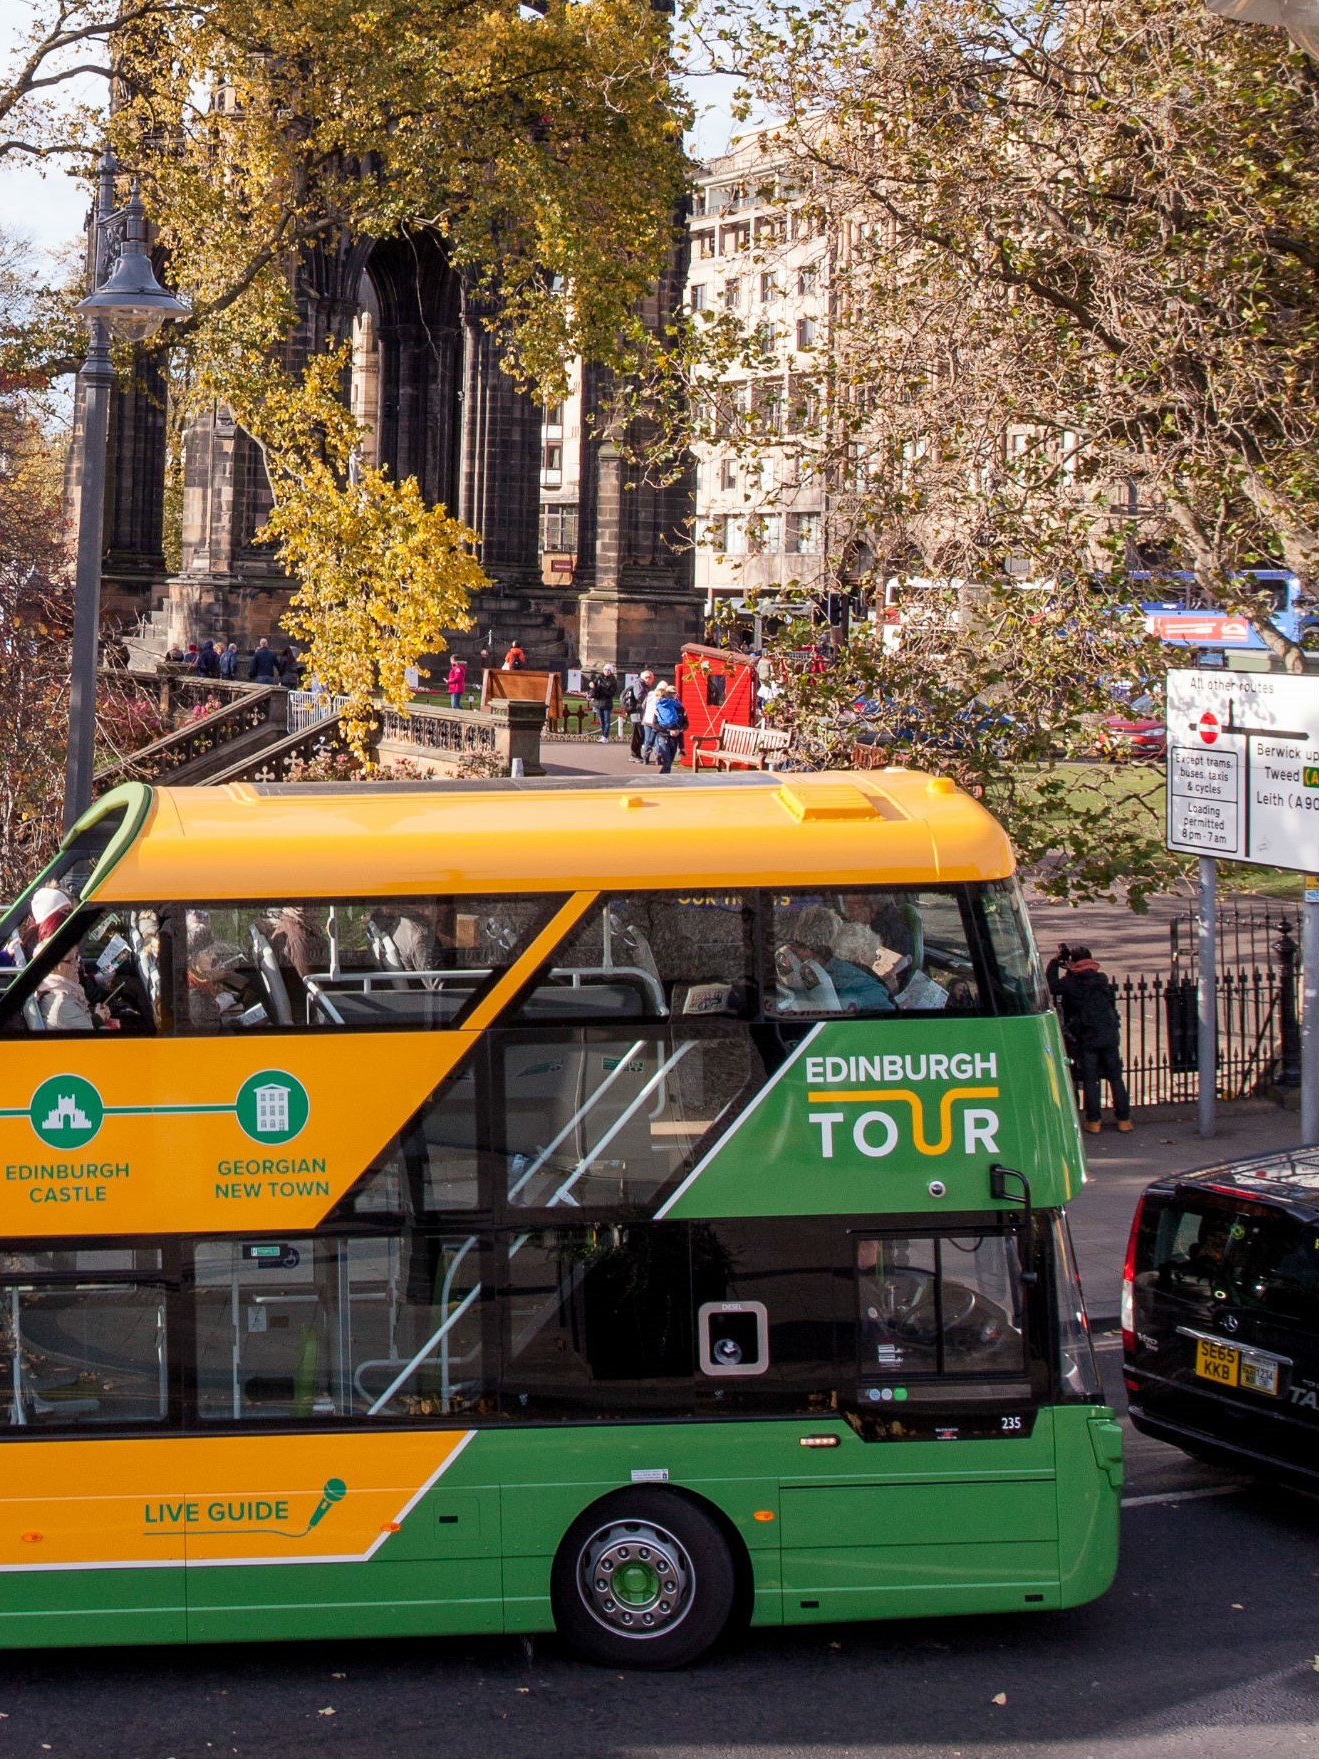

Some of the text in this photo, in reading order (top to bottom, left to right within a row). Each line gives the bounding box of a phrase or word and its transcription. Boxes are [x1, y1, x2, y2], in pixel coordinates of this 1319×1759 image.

[1190, 677, 1274, 694] All other routes
[1257, 742, 1301, 759] Berwick
[1175, 753, 1203, 766] Except
[1208, 770, 1229, 782] taxis
[1264, 765, 1300, 782] Tweed
[1187, 781, 1222, 794] & cycles
[1256, 790, 1284, 807] Leith
[1188, 802, 1221, 818] Loading
[1183, 817, 1225, 830] permitted
[806, 1052, 998, 1083] EDINBURGH
[808, 1107, 1000, 1158] TOUR
[5, 1162, 130, 1181] EDINBURGH
[217, 1158, 326, 1176] GEORGIAN
[29, 1186, 106, 1203] CASTLE
[215, 1180, 330, 1199] NEW TOWN
[721, 1303, 742, 1311] DIESEL
[1201, 1341, 1235, 1363] SE65
[1204, 1360, 1230, 1380] KKB
[1289, 1385, 1319, 1410] TA
[1001, 1416, 1022, 1430] 235
[144, 1500, 289, 1524] LIVE GUIDE
